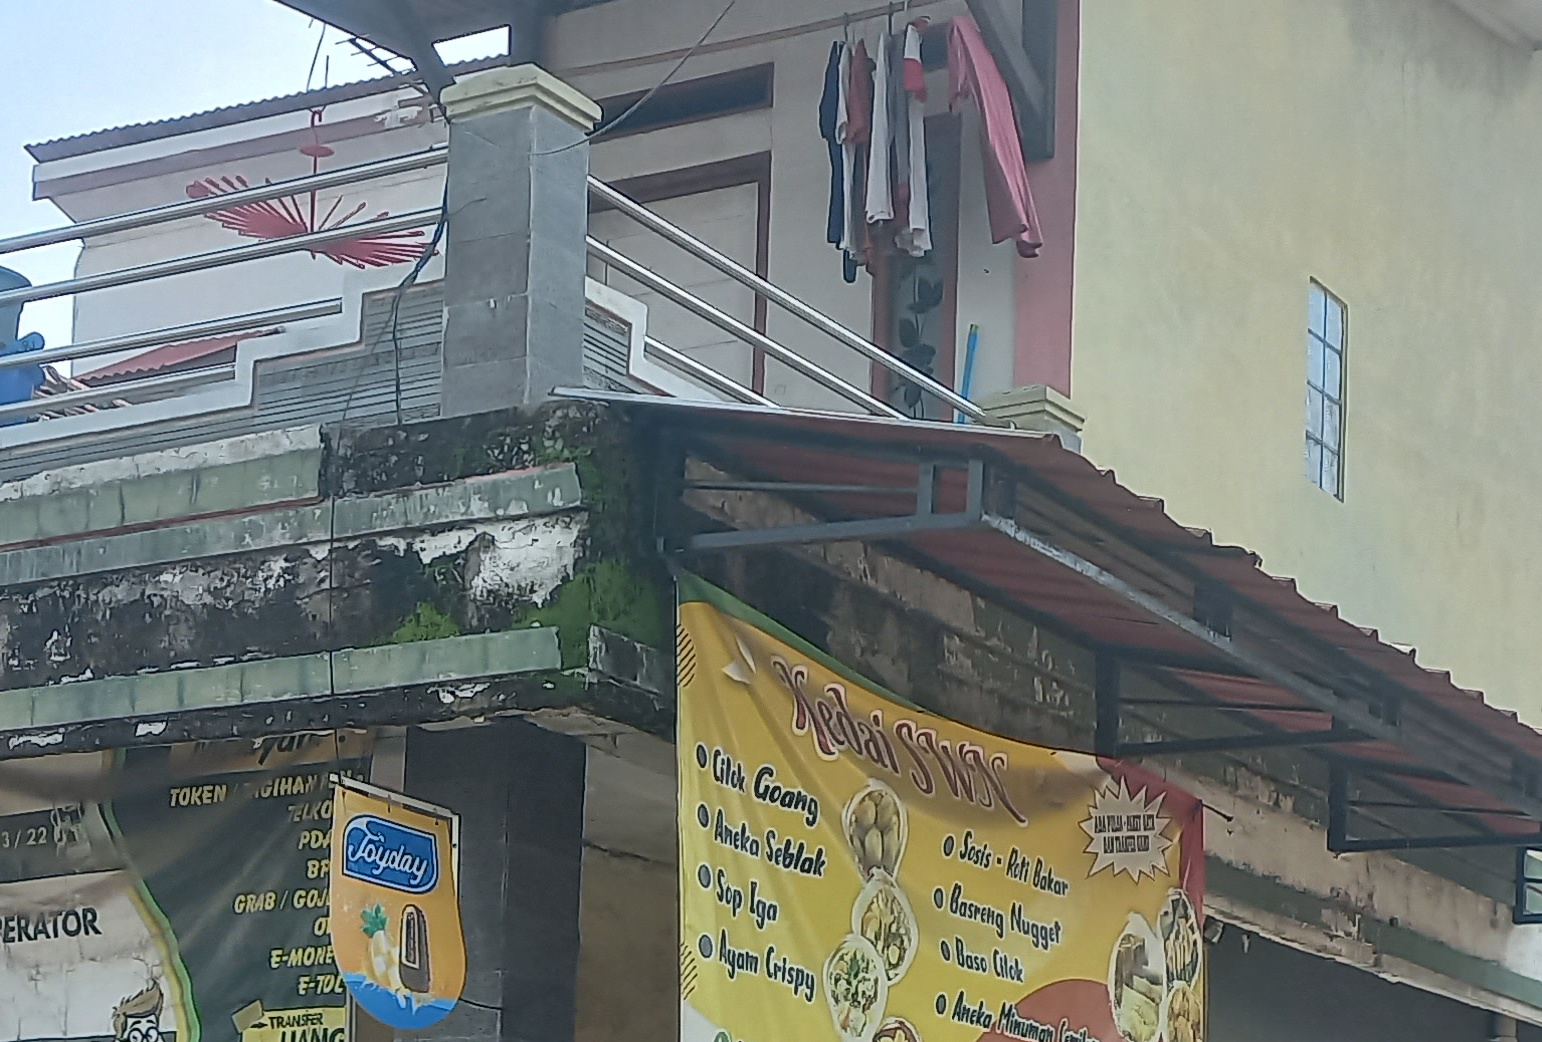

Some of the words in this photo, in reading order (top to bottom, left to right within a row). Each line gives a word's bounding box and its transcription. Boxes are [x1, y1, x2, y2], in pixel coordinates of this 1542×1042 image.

[772, 657, 900, 775] Kedai
[894, 720, 1027, 826] SWN
[170, 785, 227, 807] TOKEN
[754, 766, 818, 827] Goang
[25, 827, 47, 846] 22
[714, 809, 759, 857] Aneka
[765, 830, 826, 877] Seblak
[959, 830, 991, 869] Sosis
[1006, 847, 1030, 883] Roti
[1033, 857, 1068, 897] Bakar
[234, 891, 276, 913] GRAB
[280, 890, 289, 910] /
[716, 869, 743, 917] Sop
[749, 881, 778, 929] Iga
[950, 883, 1003, 939] Basreng
[1010, 902, 1061, 950] Nugget
[719, 929, 759, 979] Ayam
[766, 946, 815, 1002] Crispy
[955, 936, 987, 973] Baso
[993, 949, 1023, 983] Cilok
[269, 1013, 323, 1030] TRANSFER
[952, 990, 992, 1029] Aneka
